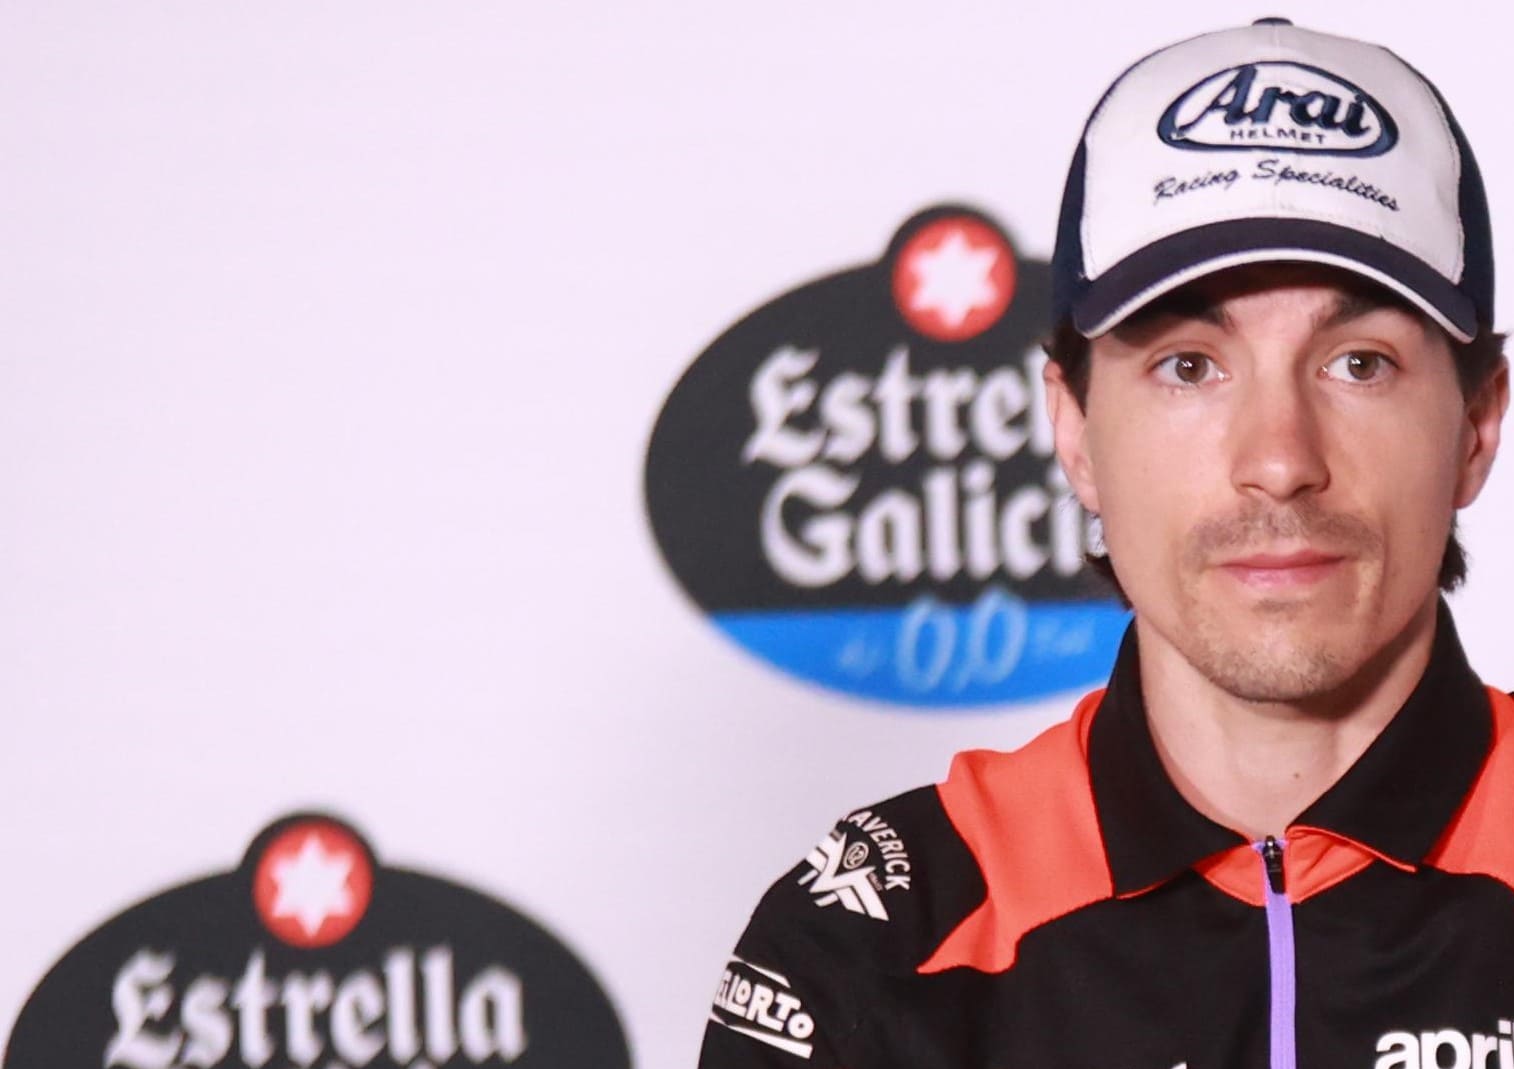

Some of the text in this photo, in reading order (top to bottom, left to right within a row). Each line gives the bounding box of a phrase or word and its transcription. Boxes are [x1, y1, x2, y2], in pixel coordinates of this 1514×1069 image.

[1171, 65, 1371, 139] Arai
[1230, 127, 1325, 145] HELMET
[1153, 158, 1400, 212] Racing Specialities
[741, 344, 1055, 466] Estrel
[842, 810, 911, 890] AVERICK
